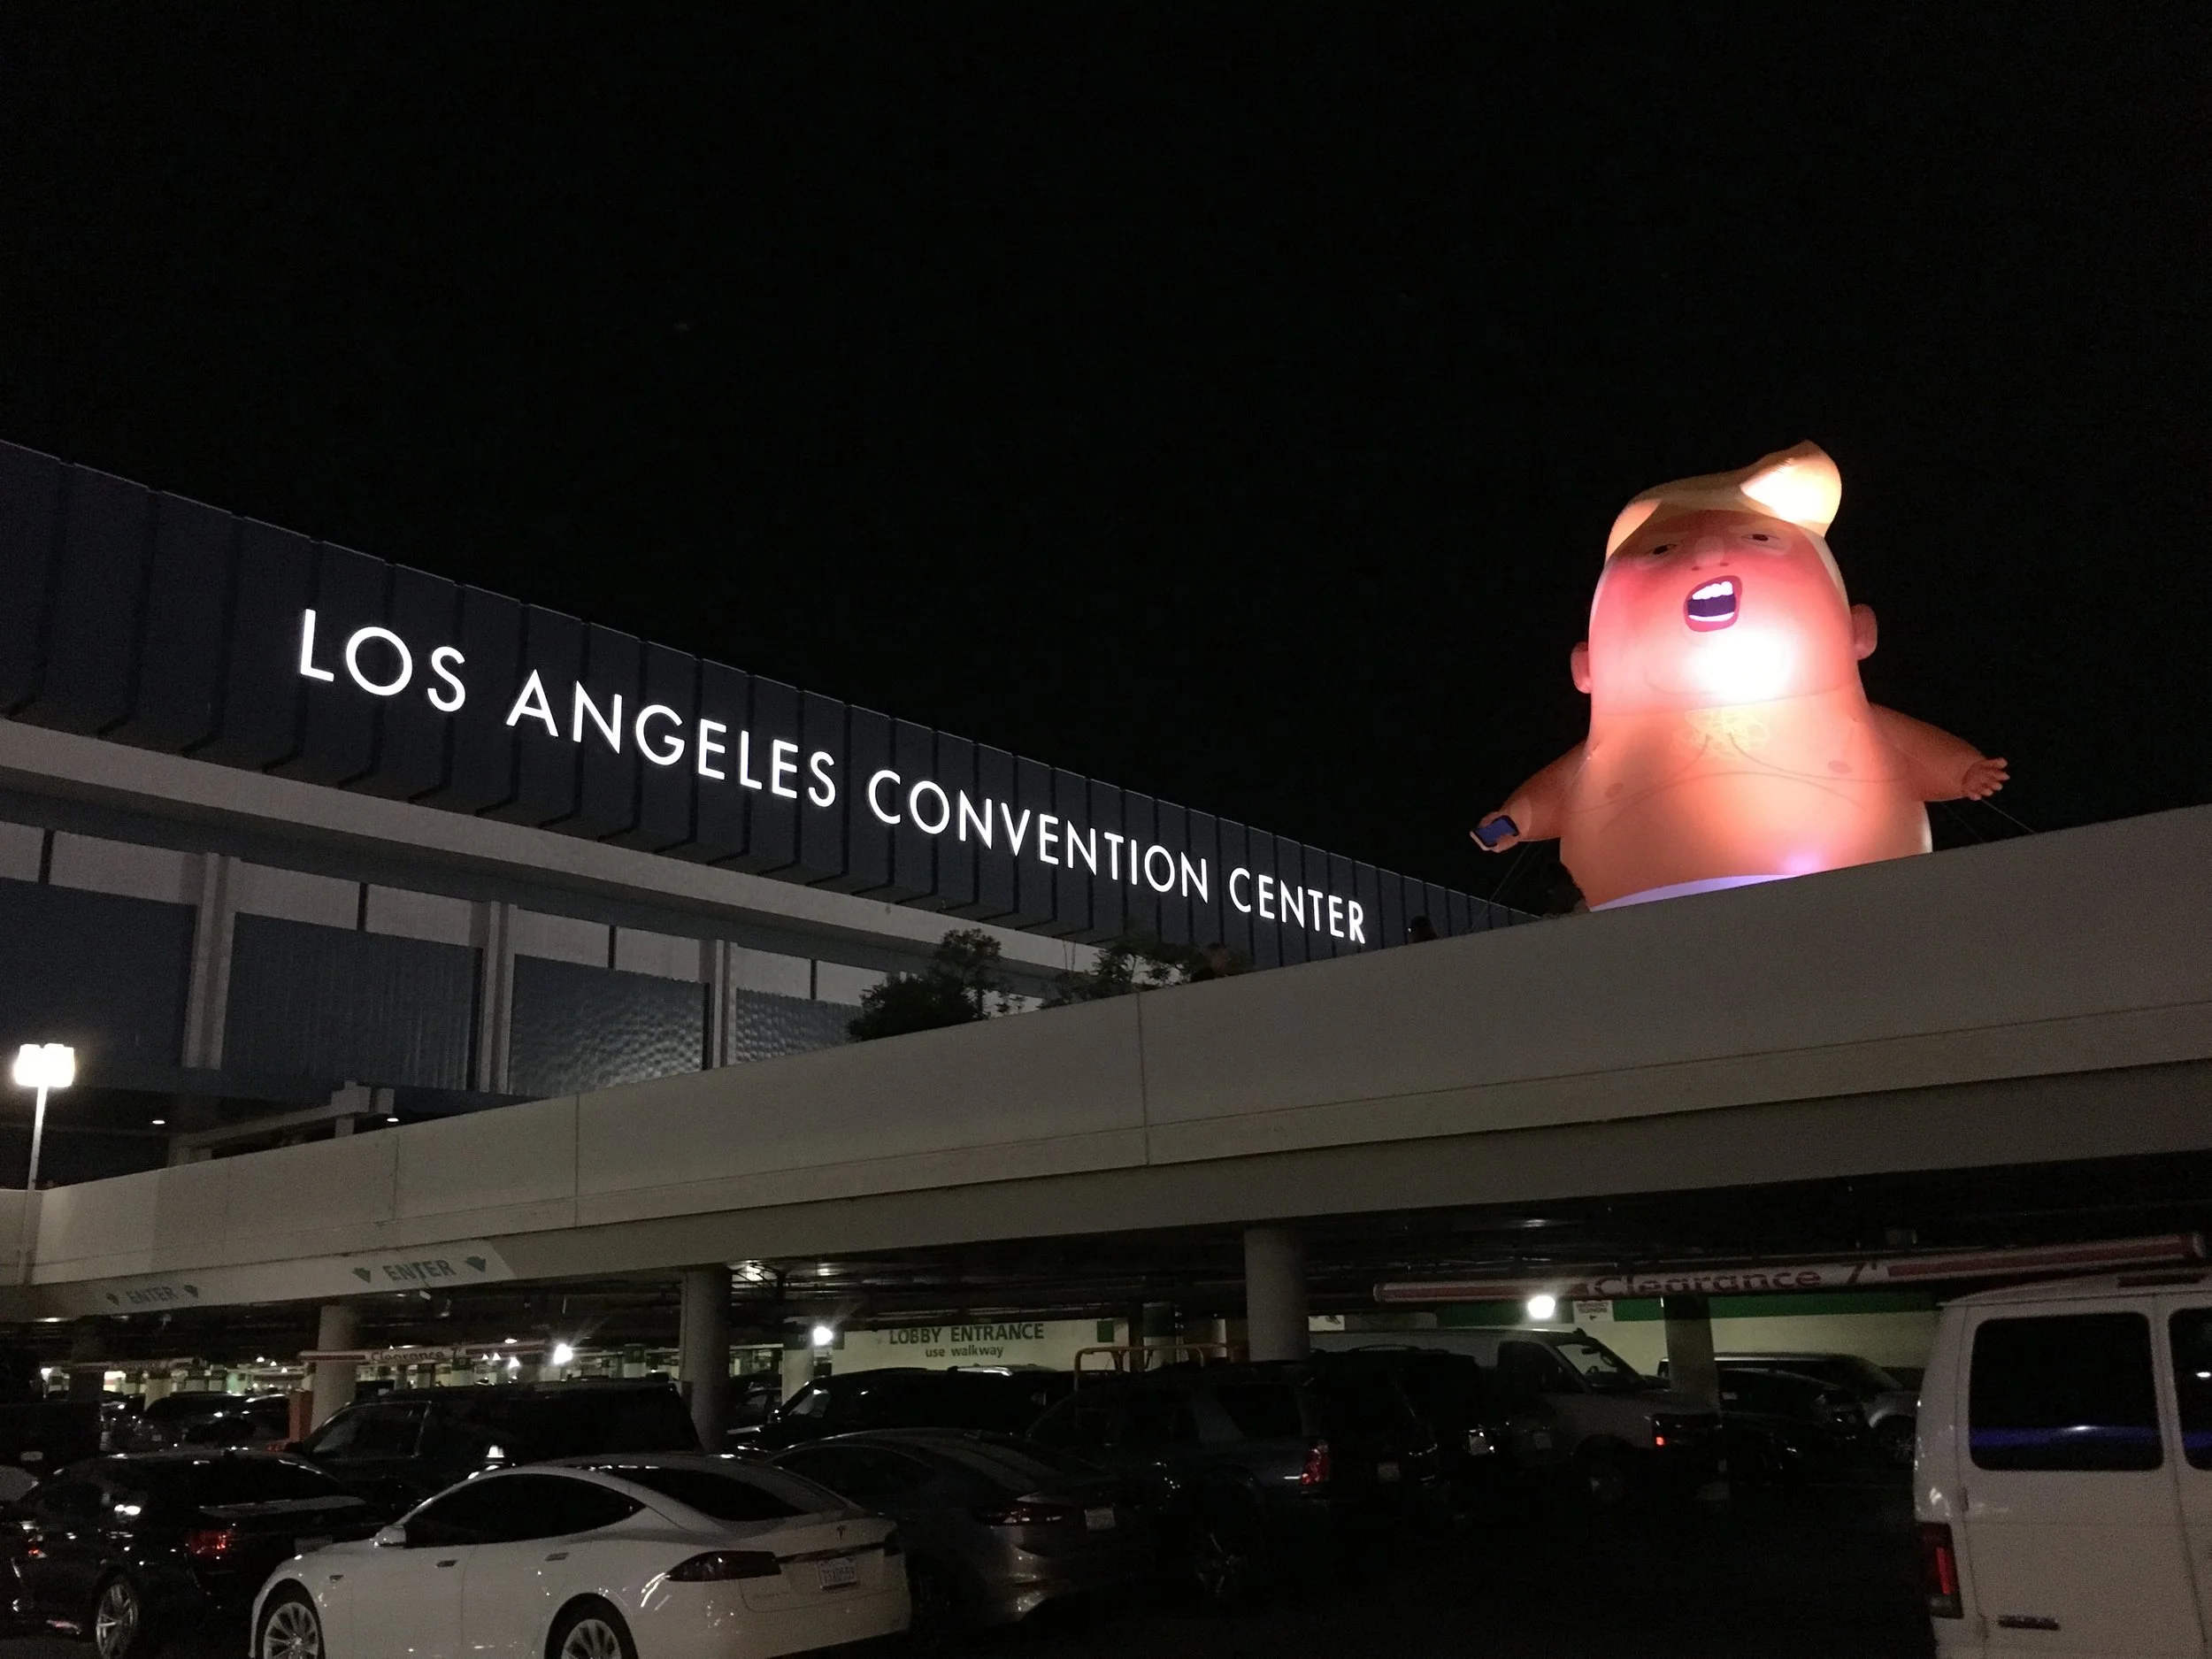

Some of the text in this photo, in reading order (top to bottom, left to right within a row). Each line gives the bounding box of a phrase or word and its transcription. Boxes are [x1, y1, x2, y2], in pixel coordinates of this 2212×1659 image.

[299, 608, 1366, 944] LOS ANGELES CONVENTION CENTER
[382, 1260, 457, 1280] ENTER
[1594, 1269, 1821, 1295] Clearance
[126, 1286, 179, 1305] ENTER
[889, 1324, 1044, 1344] LOBBY ENTRANCE
[371, 1350, 444, 1363] Clearance
[926, 1344, 1003, 1357] use walkway
